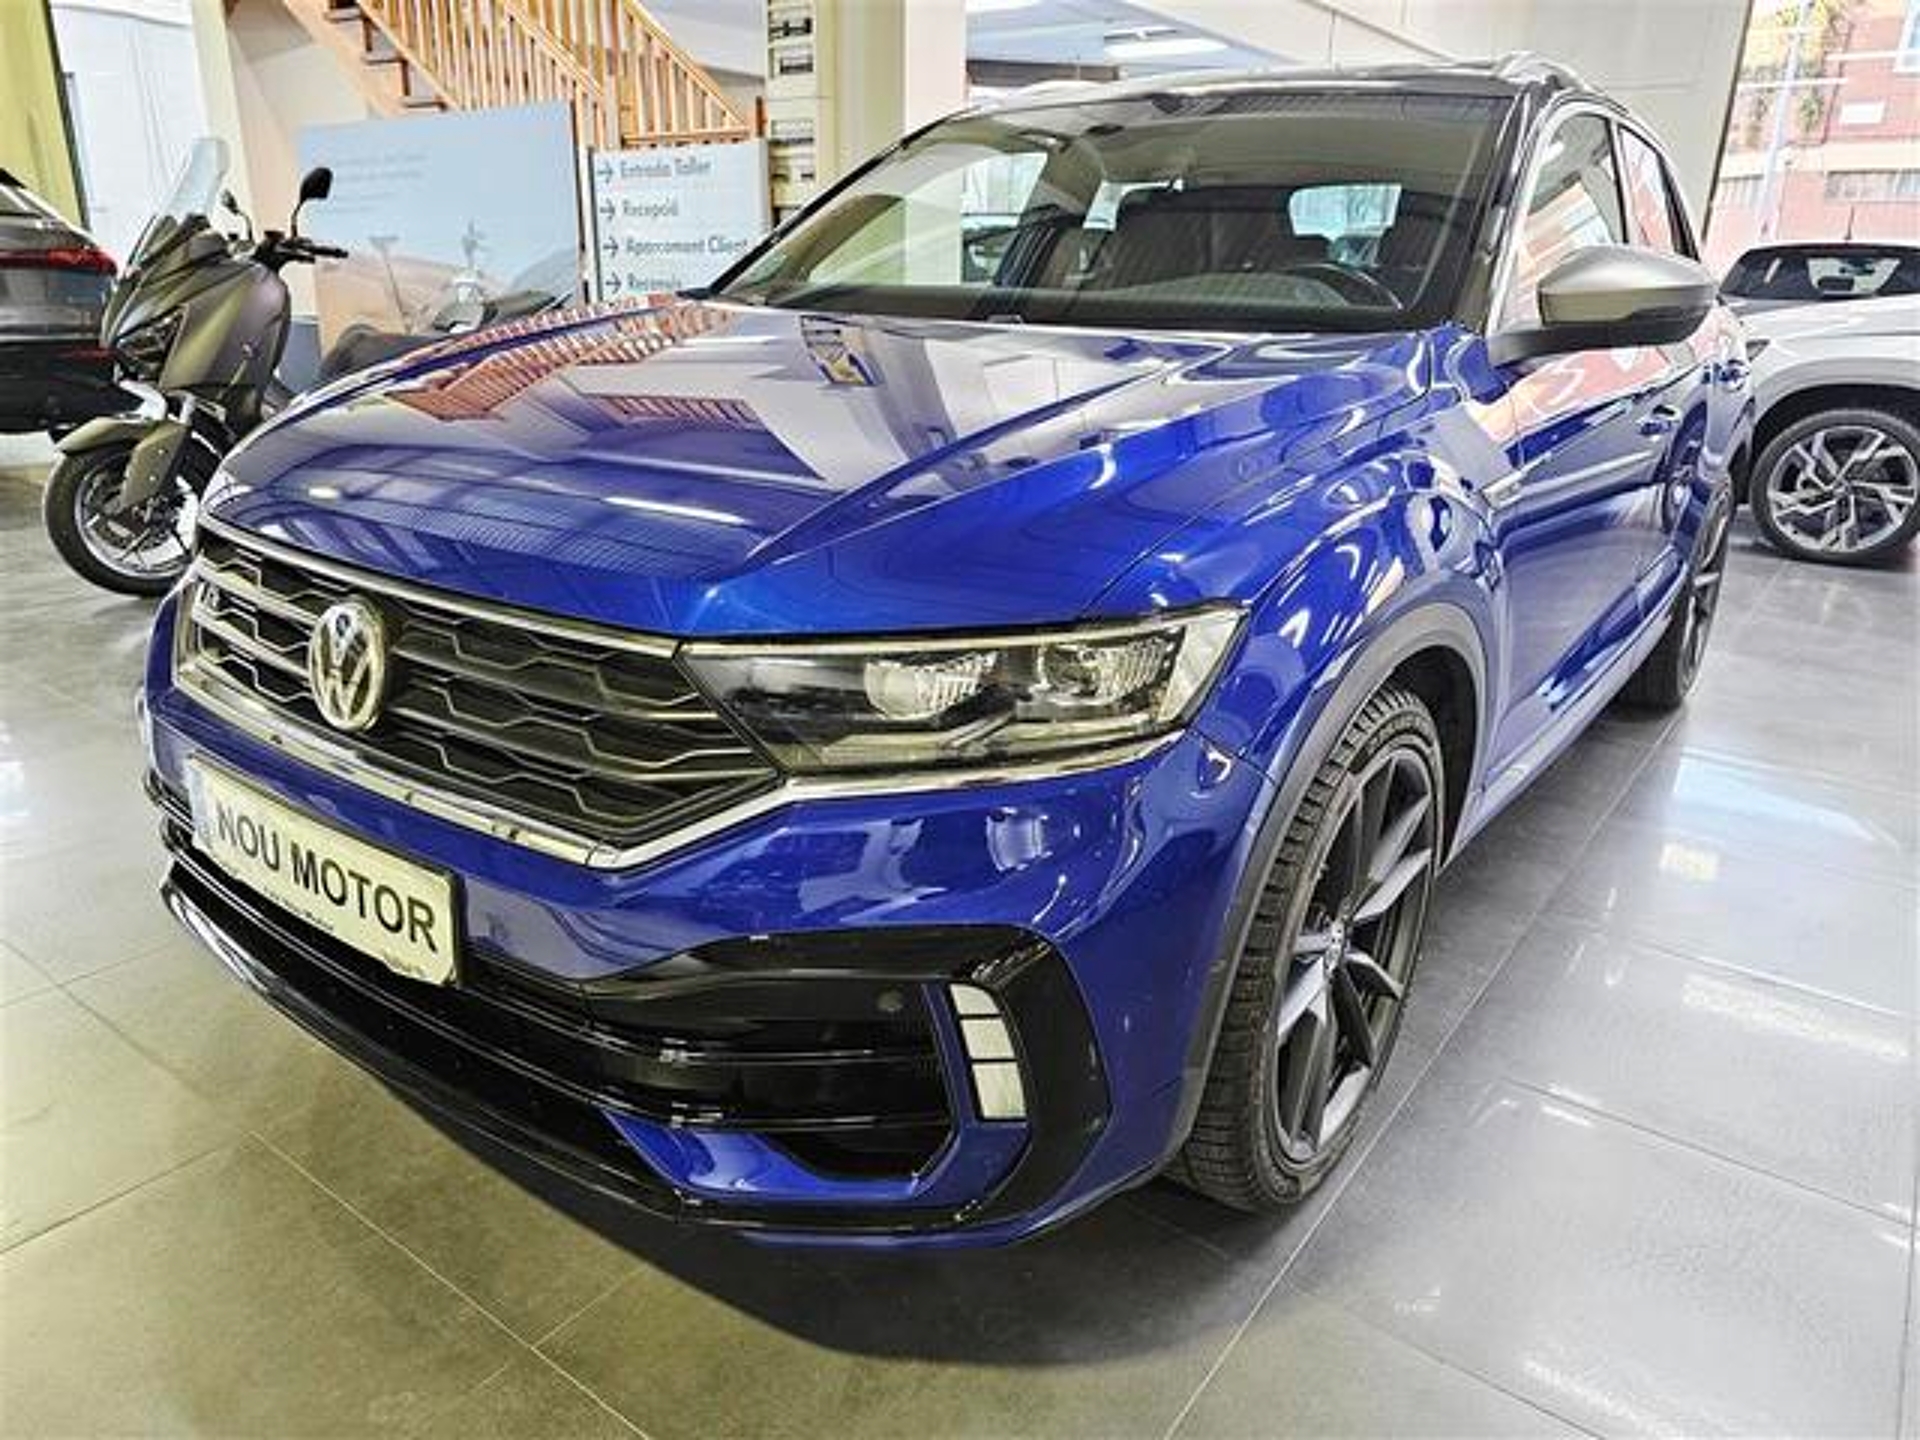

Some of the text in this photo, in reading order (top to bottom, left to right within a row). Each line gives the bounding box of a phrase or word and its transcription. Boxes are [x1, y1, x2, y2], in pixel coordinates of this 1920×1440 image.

[675, 156, 712, 175] Taller
[215, 801, 280, 872] NOU
[290, 842, 438, 954] MOTOR
